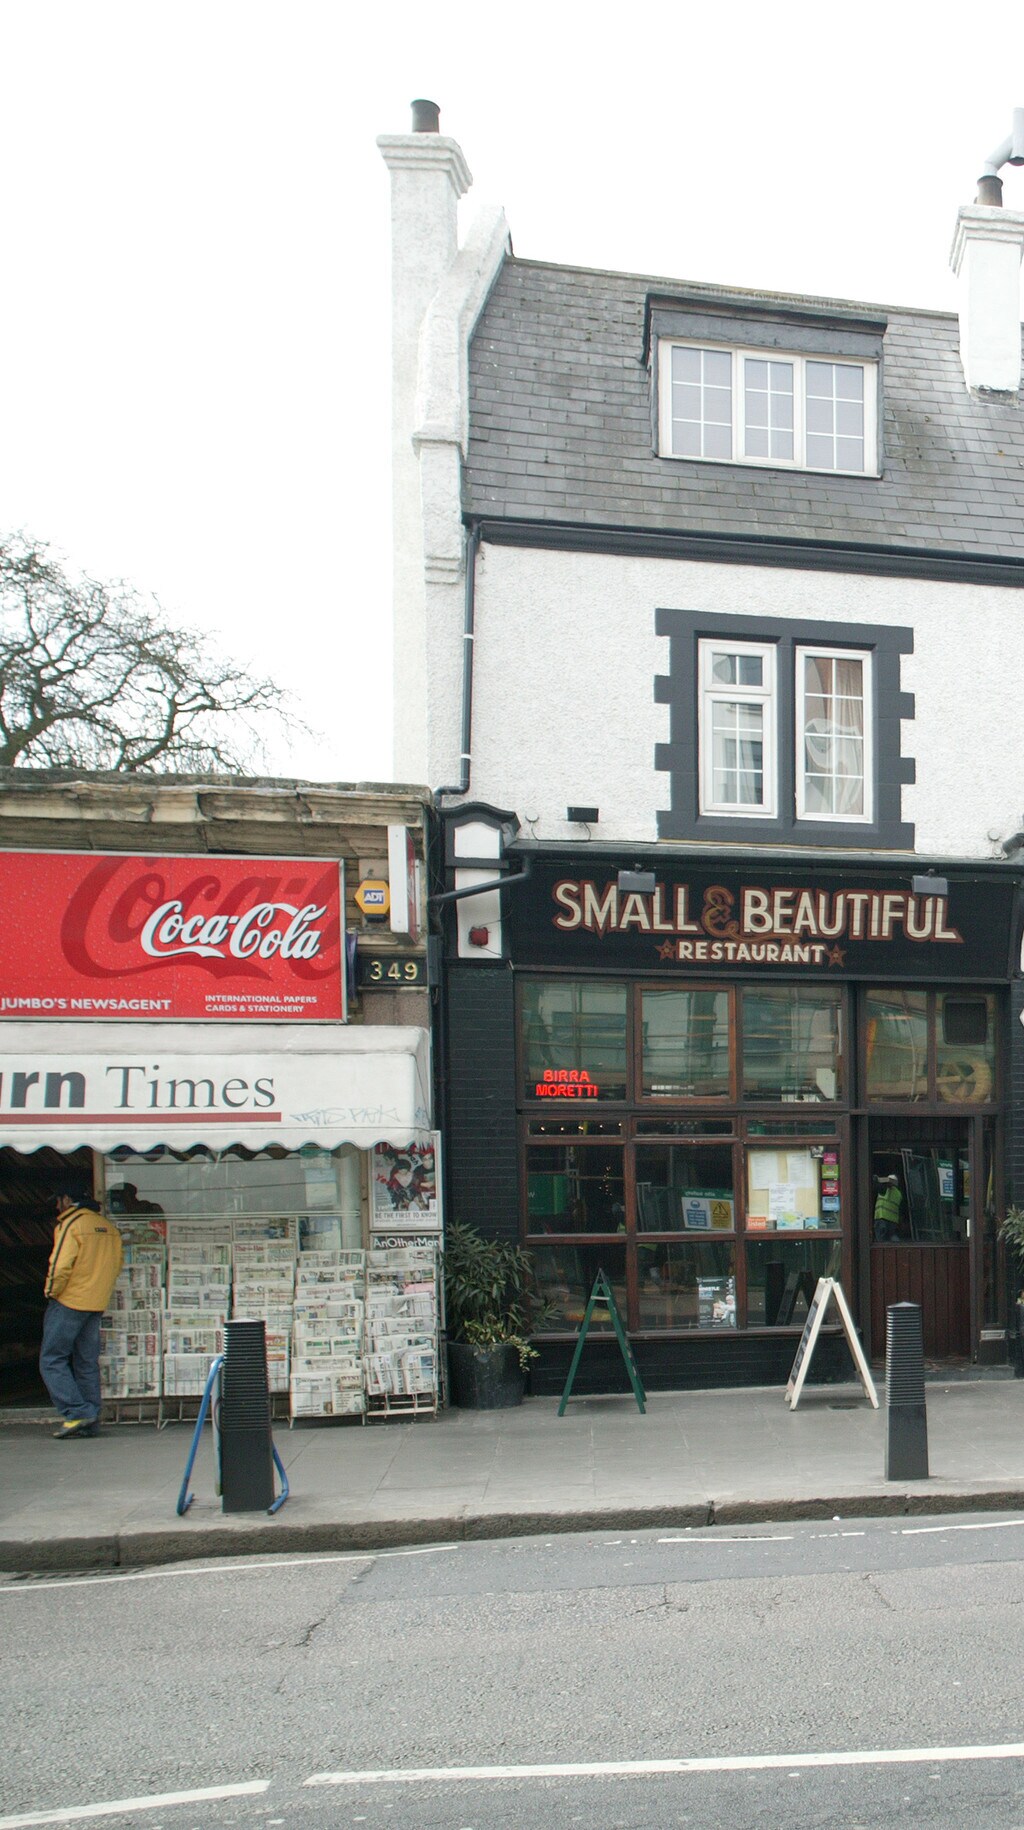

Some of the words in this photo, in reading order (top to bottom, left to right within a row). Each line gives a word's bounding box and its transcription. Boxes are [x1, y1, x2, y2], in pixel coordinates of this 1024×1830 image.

[364, 892, 384, 902] ADT
[554, 883, 698, 933] SMALL
[702, 885, 750, 938] &
[742, 888, 958, 940] BEAUTIFUL
[140, 900, 327, 960] Coca-Cola
[678, 940, 825, 964] RESTAURANT
[370, 960, 418, 980] 349
[0, 997, 67, 1010] JUMBO'S
[71, 998, 172, 1011] NEWSAGENT
[205, 995, 281, 1003] INTERNATIONAL
[283, 996, 317, 1004] PAPERS
[205, 1004, 237, 1012] CARDS
[543, 1069, 590, 1082] BIRRA
[0, 1071, 87, 1109] rn
[105, 1064, 276, 1108] Times
[535, 1084, 599, 1097] MORETTI
[395, 1211, 411, 1219] FIRST
